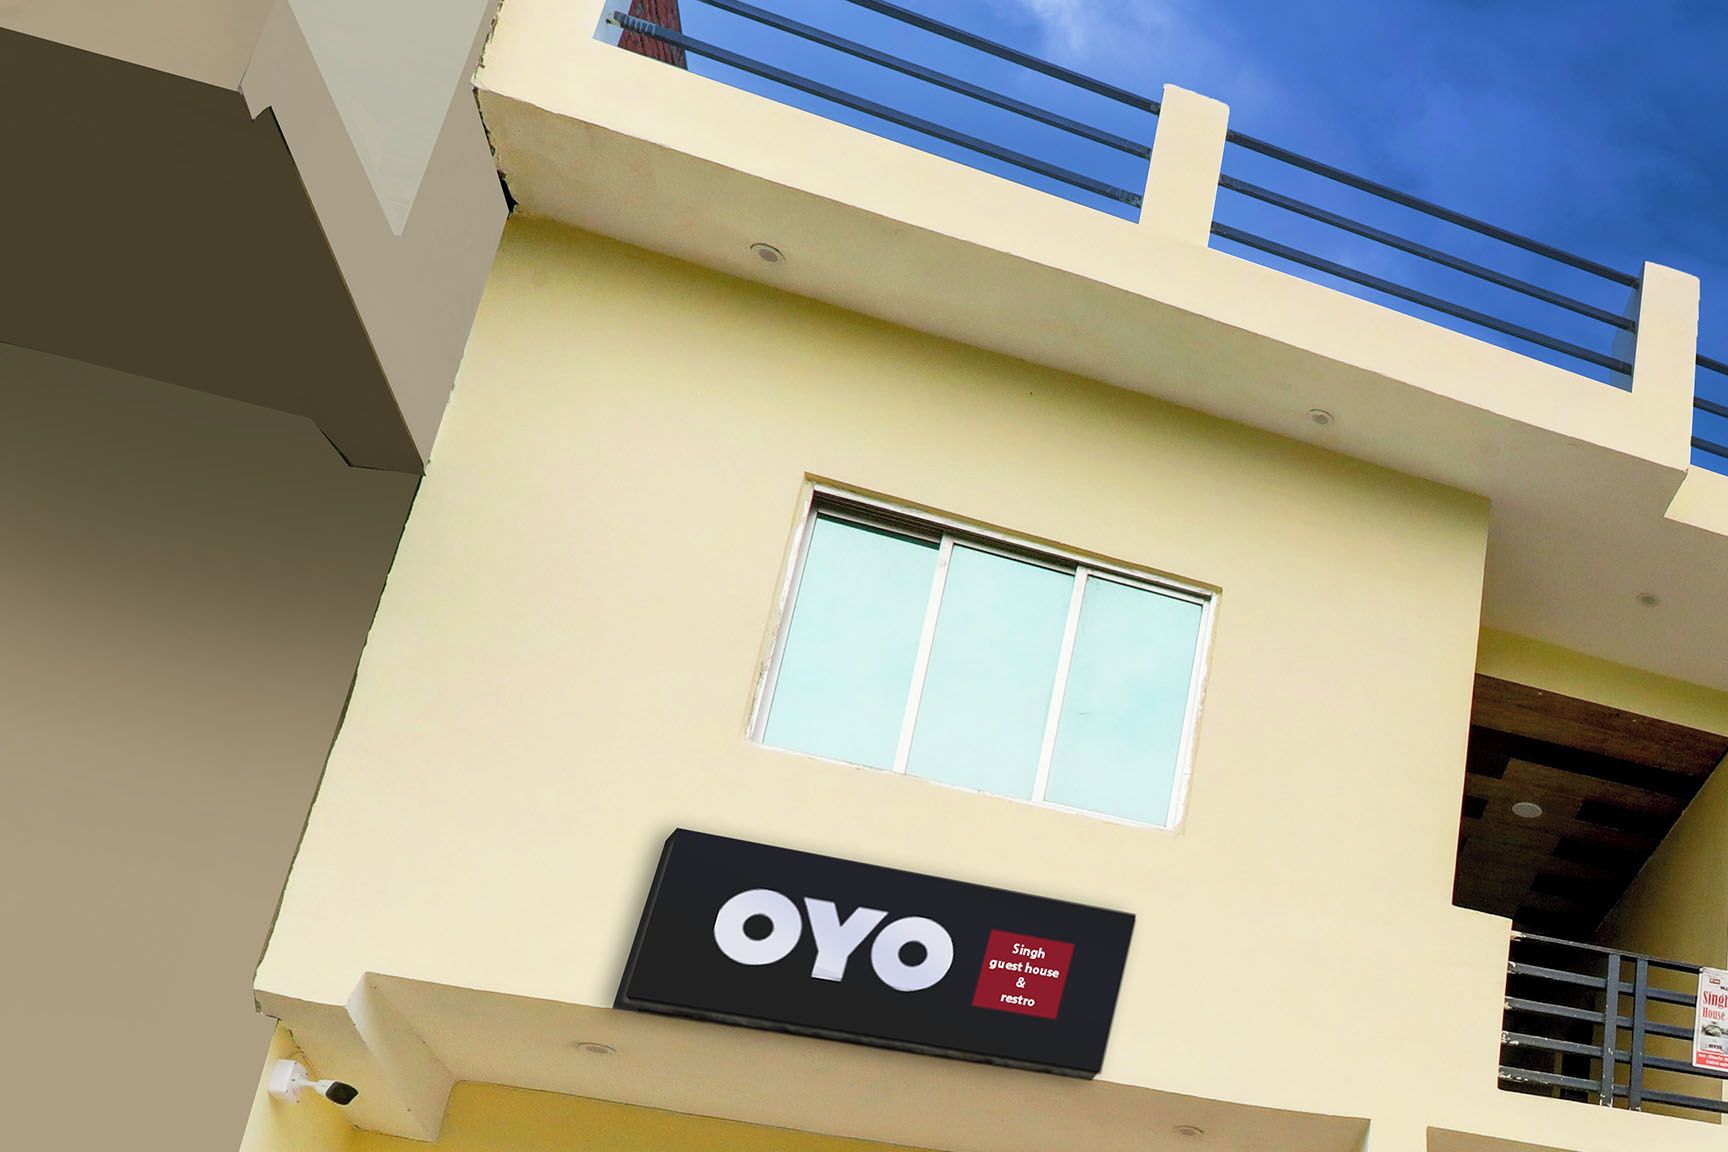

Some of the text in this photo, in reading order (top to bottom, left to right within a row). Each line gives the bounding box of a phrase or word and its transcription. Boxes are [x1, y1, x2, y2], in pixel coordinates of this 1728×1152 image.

[713, 888, 955, 992] OYO
[1011, 943, 1046, 960] Singh
[988, 959, 1060, 978] guest house
[1015, 976, 1026, 989] &
[1000, 994, 1035, 1007] restro
[1702, 1007, 1726, 1021] House
